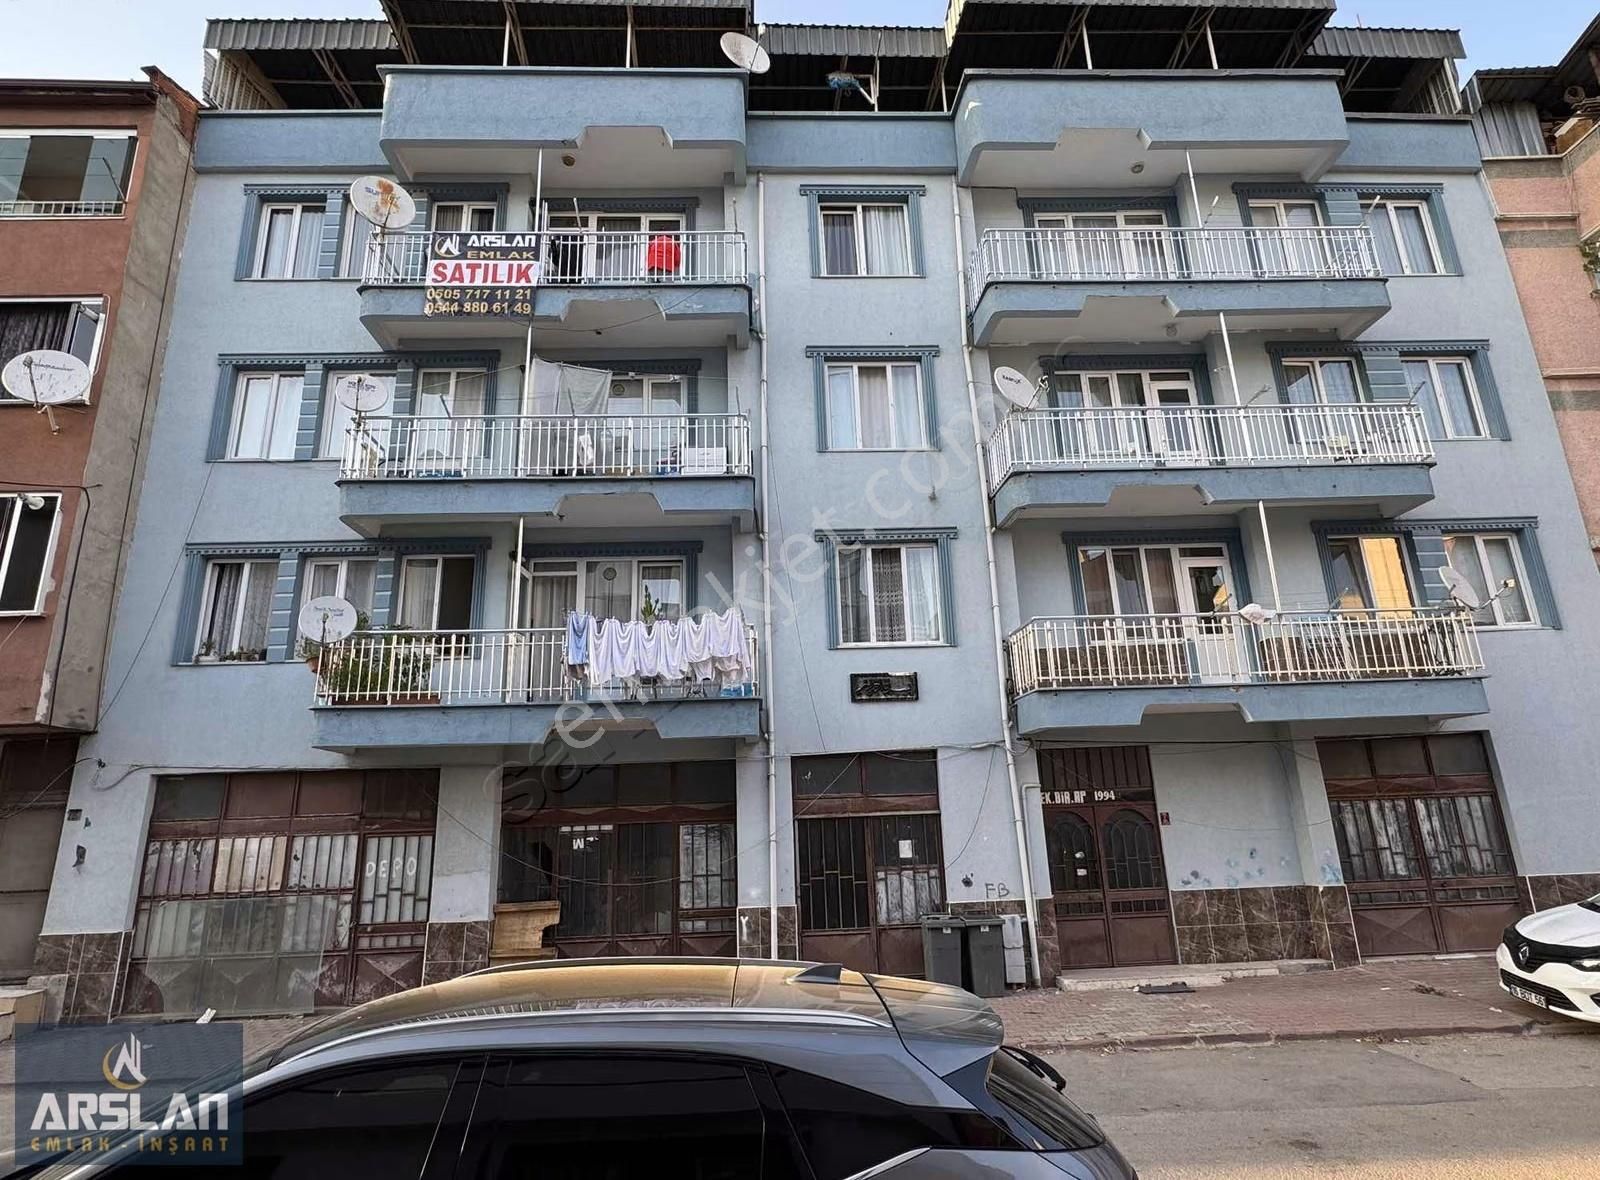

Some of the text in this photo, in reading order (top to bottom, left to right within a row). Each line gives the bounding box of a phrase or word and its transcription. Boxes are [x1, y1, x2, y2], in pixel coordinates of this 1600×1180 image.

[467, 234, 537, 248] ARSLAN
[466, 250, 535, 259] EMLAK
[431, 262, 535, 284] SATILIK
[426, 287, 531, 300] 0505 717 11 21
[425, 301, 532, 315] 0544 880 61 49
[1094, 789, 1116, 802] 1994
[366, 856, 417, 878] DEPO
[985, 882, 1010, 899] FB
